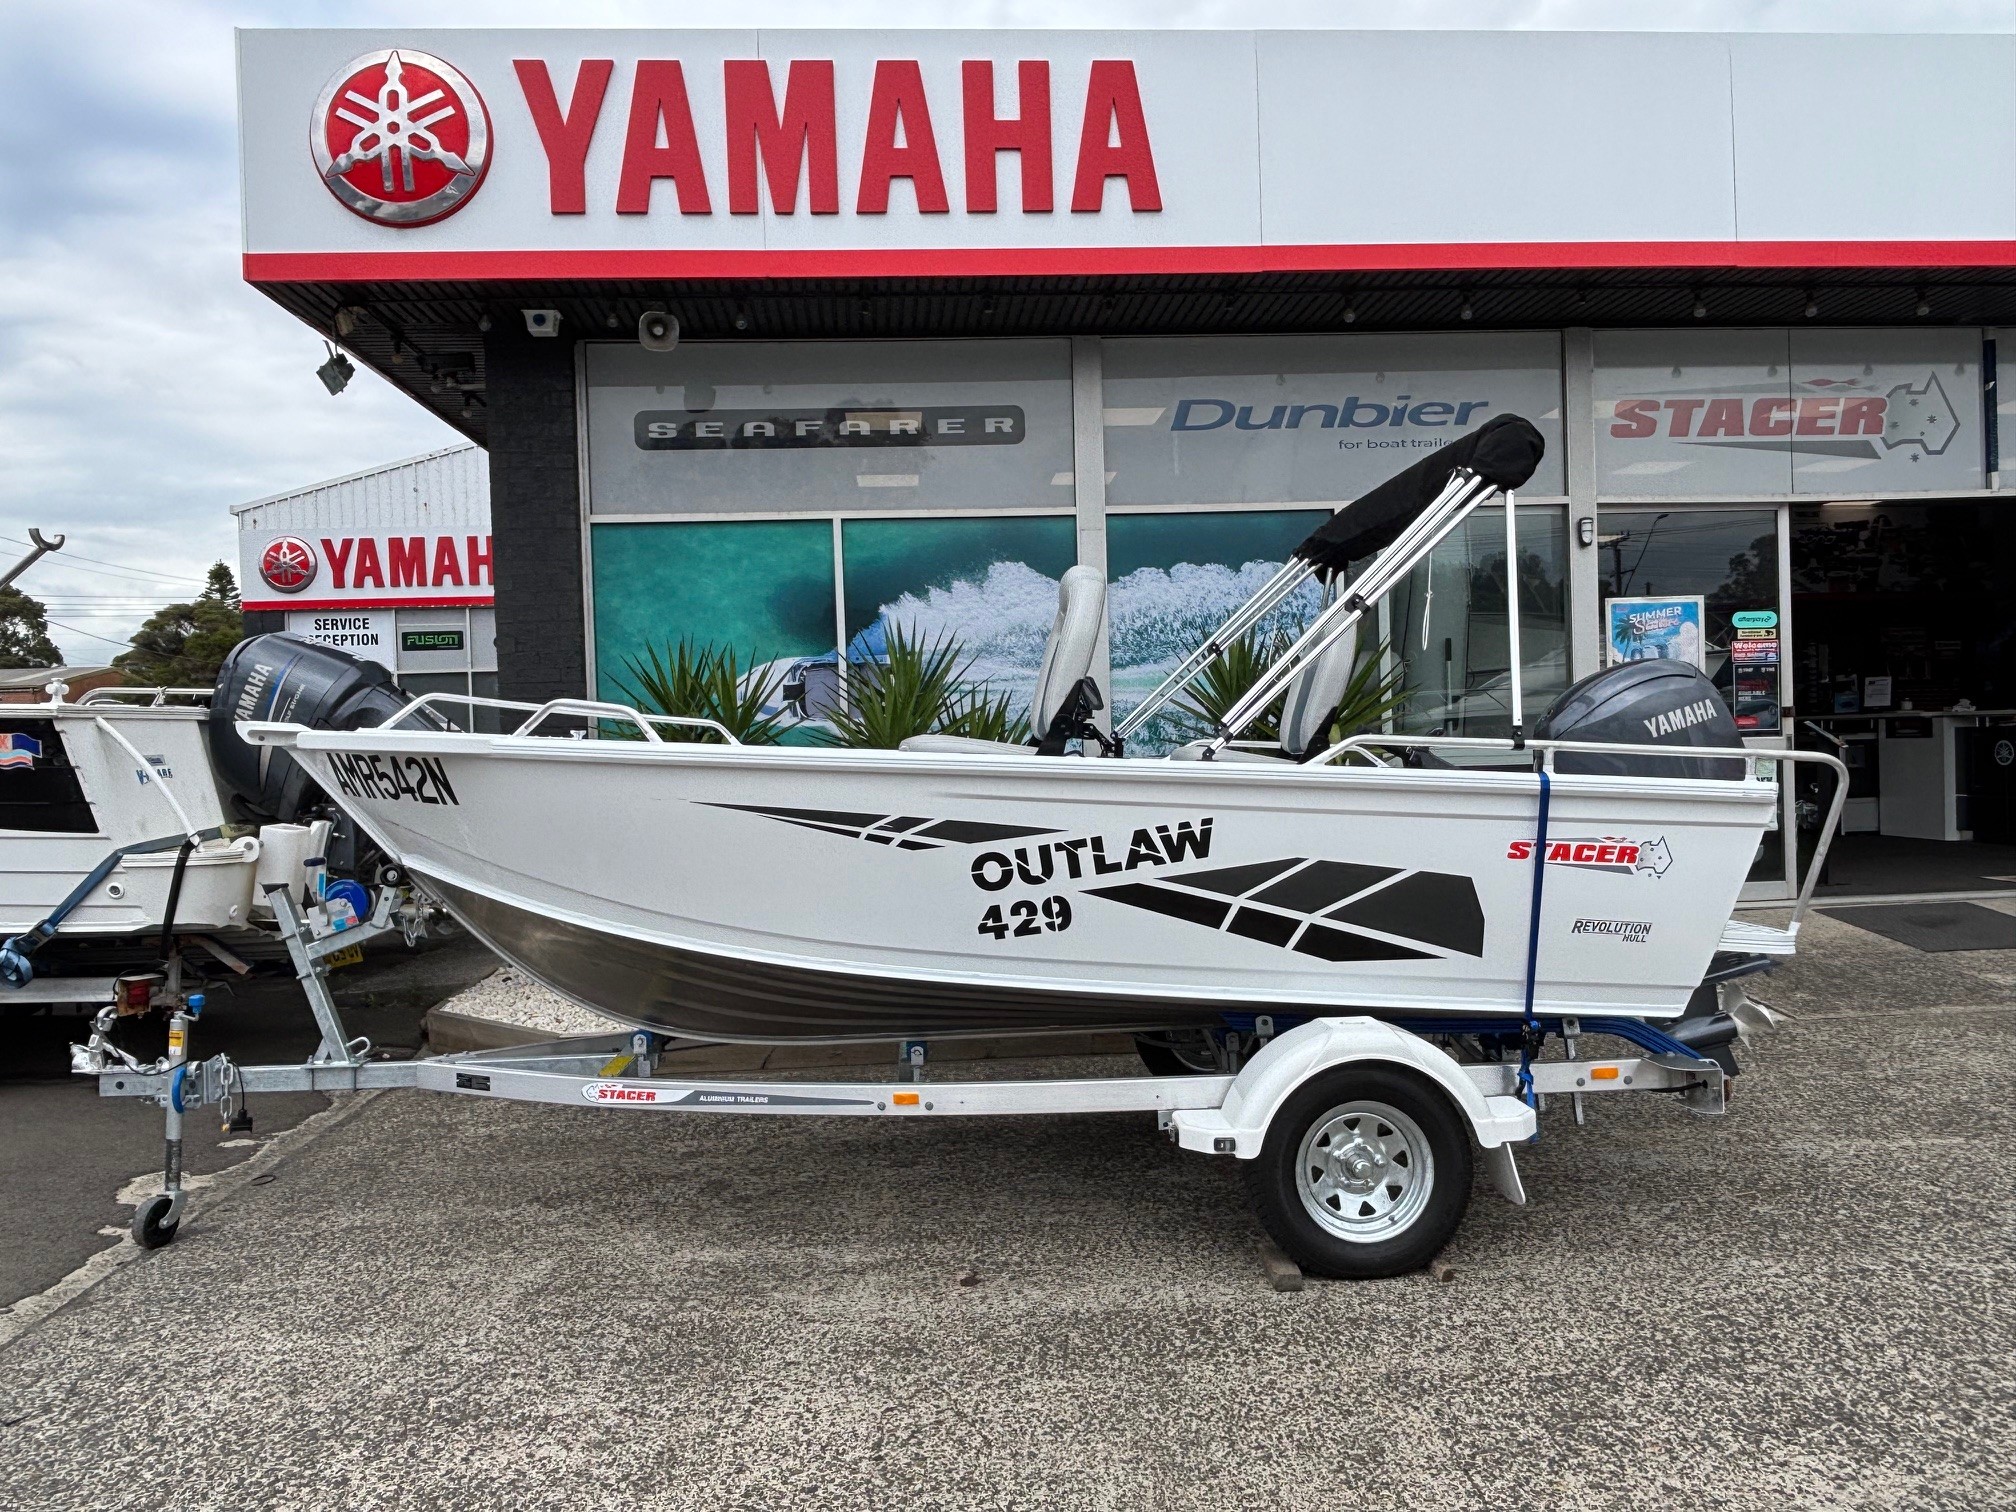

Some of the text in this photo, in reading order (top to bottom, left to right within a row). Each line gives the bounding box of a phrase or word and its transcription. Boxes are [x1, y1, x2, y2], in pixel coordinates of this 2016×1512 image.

[513, 59, 1163, 216] YAMAHA
[648, 416, 1014, 438] SEAFARER
[1170, 395, 1489, 431] Dunbier
[1610, 397, 1889, 439] STACER
[1339, 439, 1362, 449] for
[1367, 439, 1407, 449] boat
[320, 535, 493, 589] YAMAH
[314, 617, 370, 631] SERVICE
[1629, 606, 1682, 623] SUMMER
[407, 634, 458, 646] FUSION
[1643, 698, 1718, 738] YAMAHA
[326, 752, 460, 806] AMR542N
[971, 817, 1214, 892] OUTLAW
[977, 895, 1072, 940] 429
[1571, 920, 1652, 935] REVOLUTION
[1622, 934, 1647, 943] HULL
[599, 1089, 656, 1102] STACER
